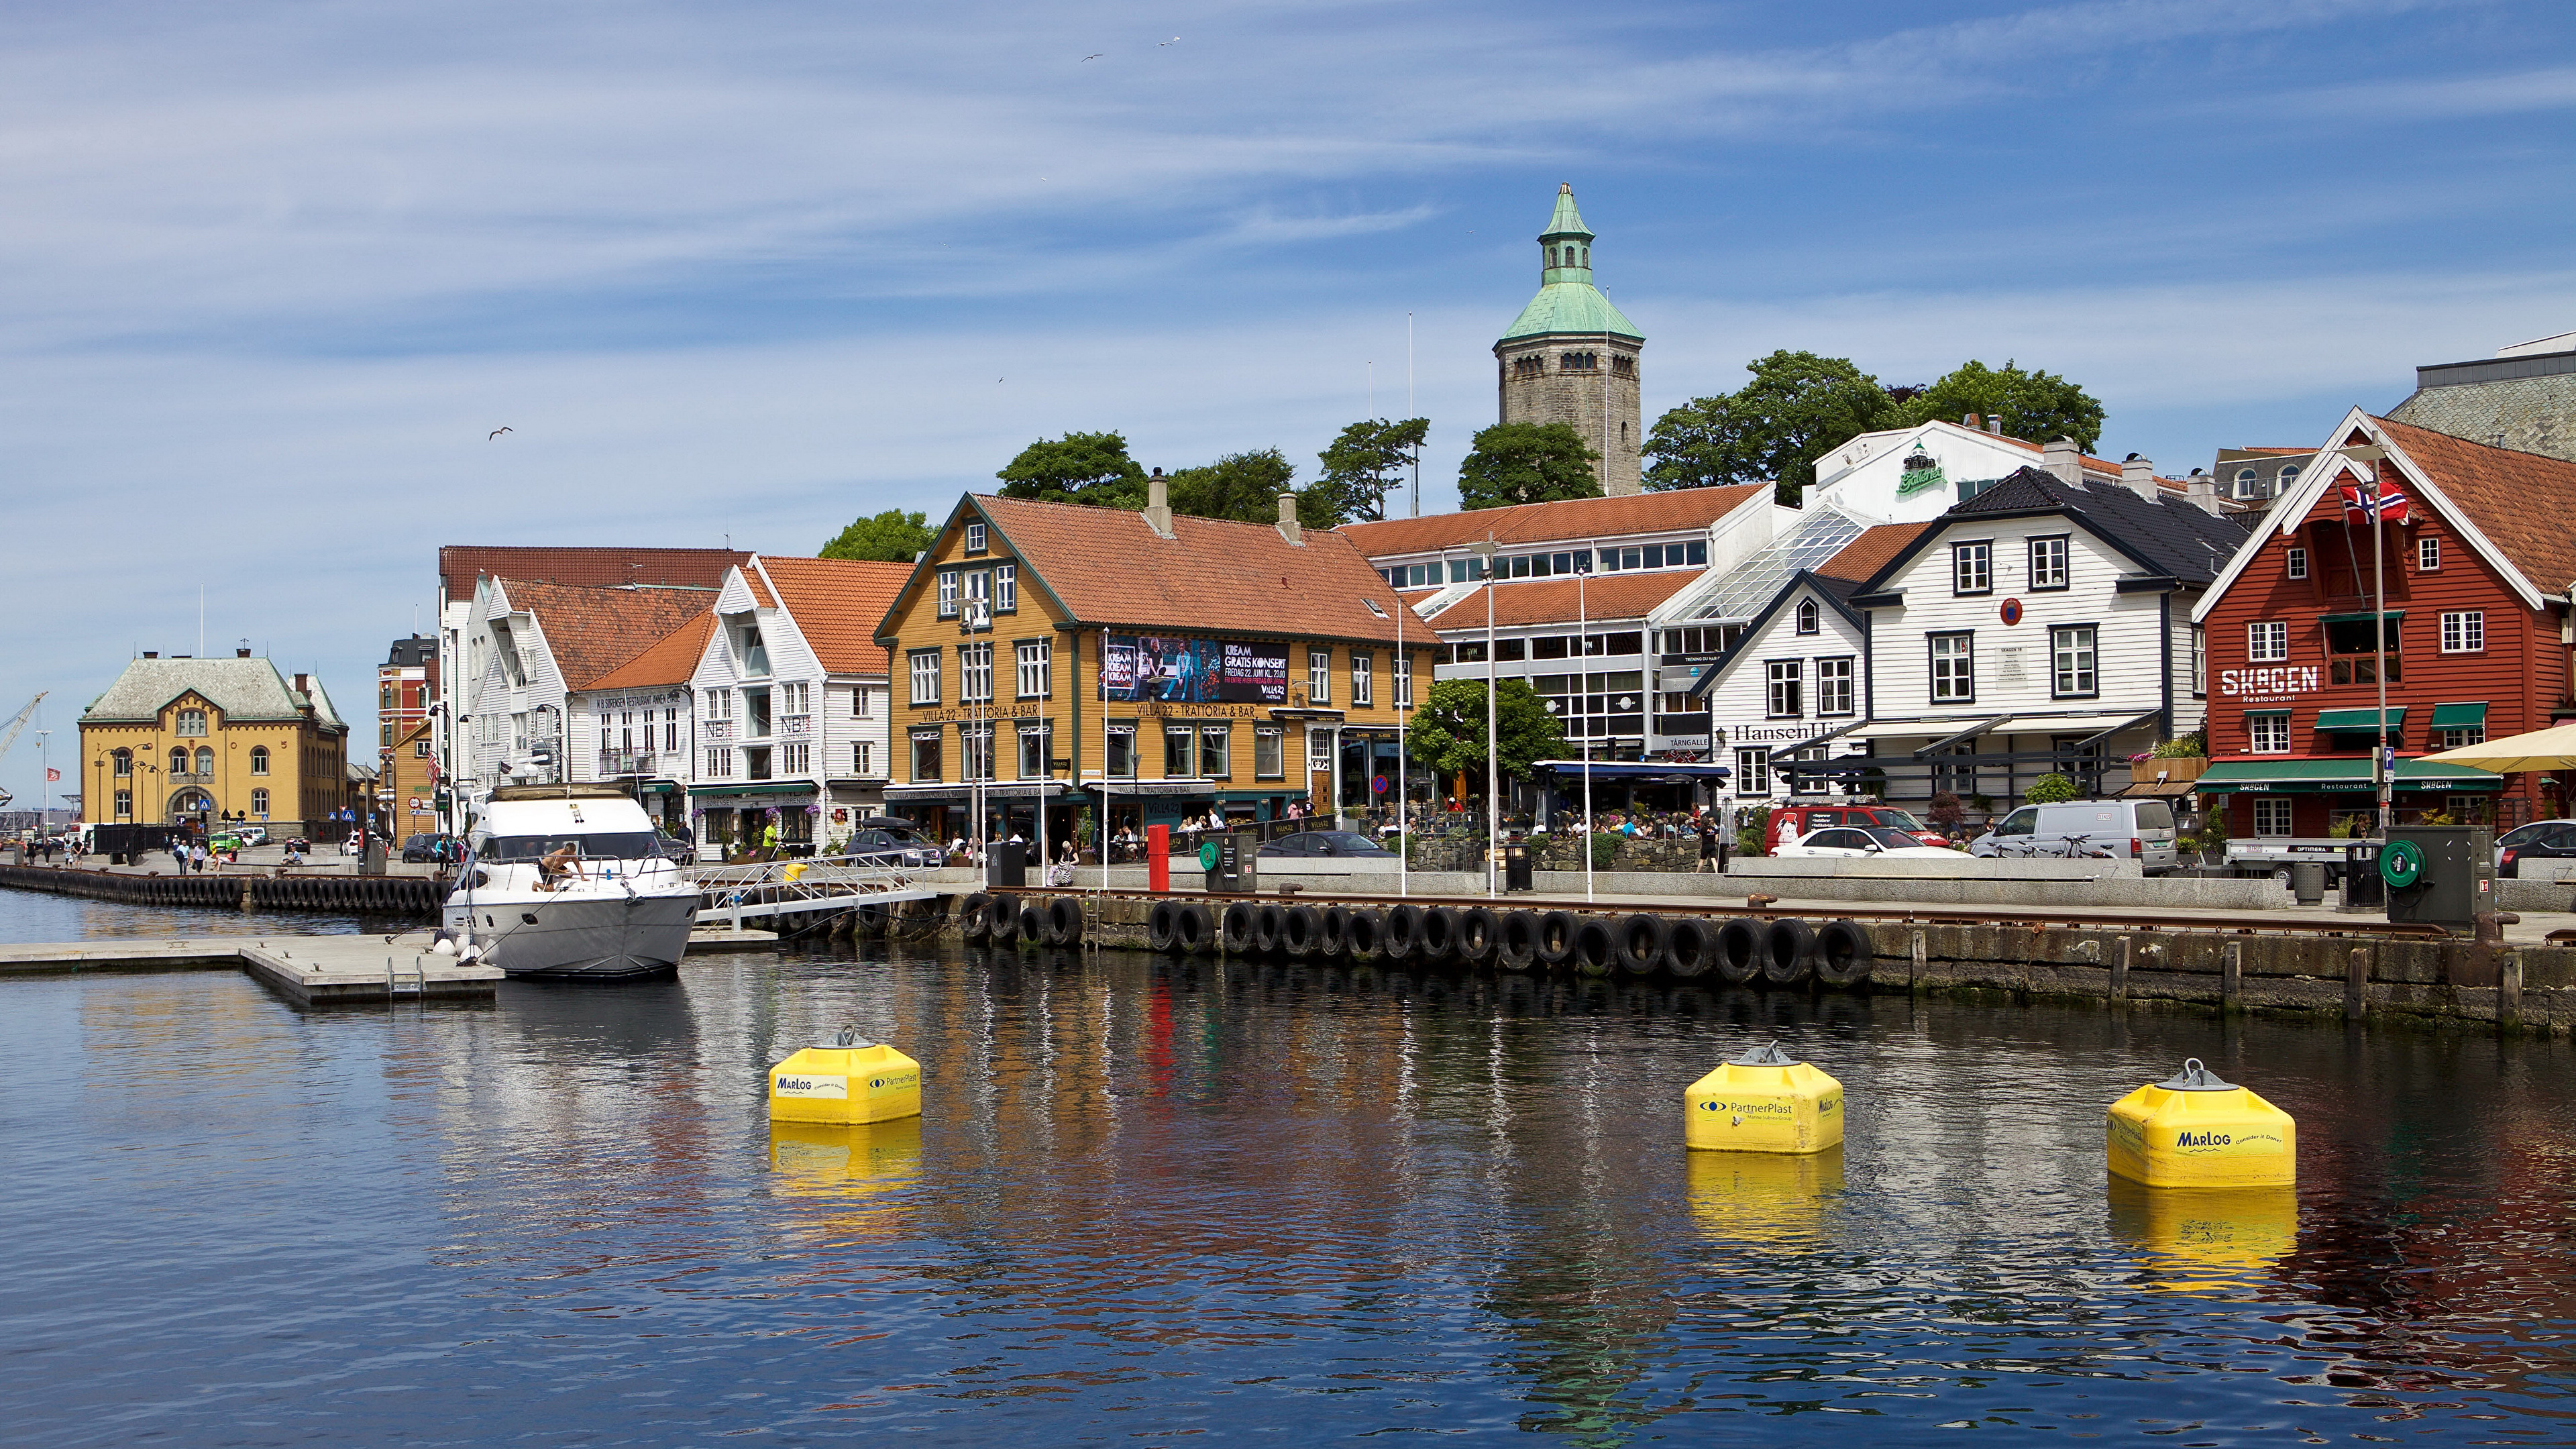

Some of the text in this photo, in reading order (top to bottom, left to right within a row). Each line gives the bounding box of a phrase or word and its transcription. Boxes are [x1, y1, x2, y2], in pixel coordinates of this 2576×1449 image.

[1226, 645, 1252, 656] KREAM
[1108, 653, 1132, 663] KREAM
[1224, 656, 1286, 669] GRATIS KONSERT
[1108, 663, 1132, 672] KREAM
[1225, 668, 1244, 677] FREDAG
[1253, 669, 1264, 678] JUNI
[1274, 670, 1285, 678] 23.00
[1108, 672, 1132, 681] KREAM
[2221, 666, 2318, 695] SKAGEN
[627, 696, 652, 706] RESTAURANT
[652, 694, 666, 704] ANNEN
[2243, 694, 2295, 703] Restaurant
[923, 710, 945, 722] VILLA
[946, 709, 956, 721] 22
[1012, 706, 1018, 718] &
[1020, 704, 1038, 716] BAR
[1136, 704, 1161, 716] VILLA
[1162, 704, 1173, 716] 22
[1181, 705, 1226, 717] TRATTORIA
[1230, 706, 1236, 717] &
[1239, 706, 1255, 718] BAR
[2240, 783, 2269, 792] SKAGEN
[2420, 780, 2453, 790] SKAGEN
[886, 1073, 916, 1086] PartnerPlast
[1731, 1102, 1792, 1114] PartnerPlast
[2236, 1135, 2259, 1145] Consider
[2266, 1134, 2282, 1143] Done!
